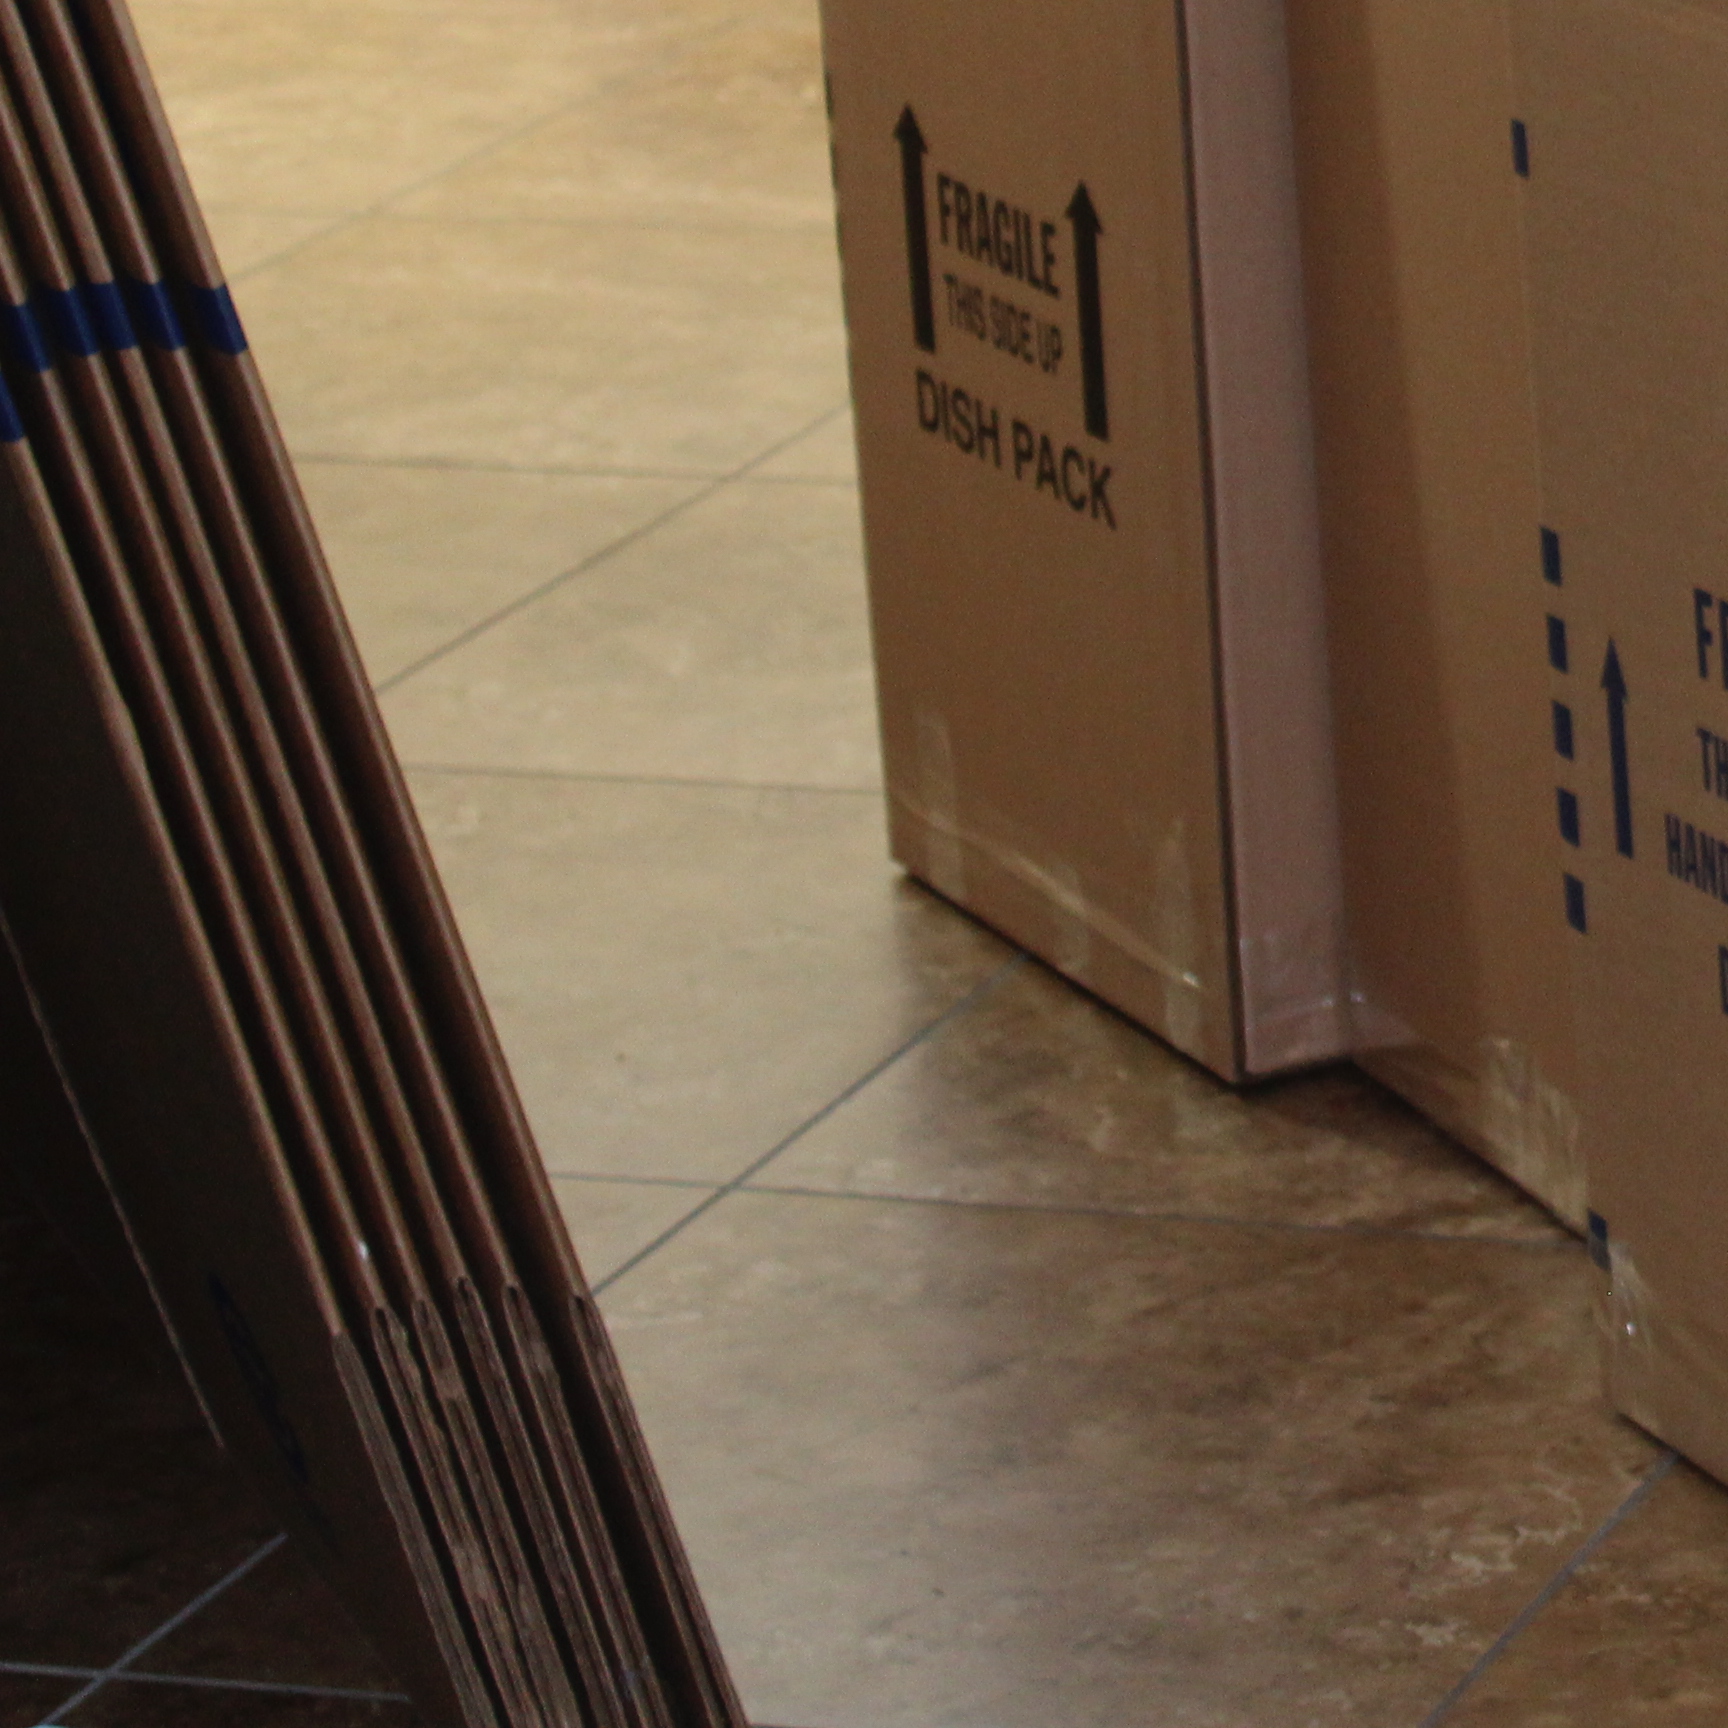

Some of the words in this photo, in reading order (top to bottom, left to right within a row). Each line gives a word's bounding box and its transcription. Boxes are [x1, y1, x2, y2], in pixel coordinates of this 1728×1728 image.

[937, 173, 1059, 299] FRAGILE
[943, 273, 986, 342] THIS
[990, 296, 1033, 365] SIDE
[1036, 321, 1064, 375] UP
[916, 368, 1001, 470] DISH
[1012, 418, 1117, 530] PACK
